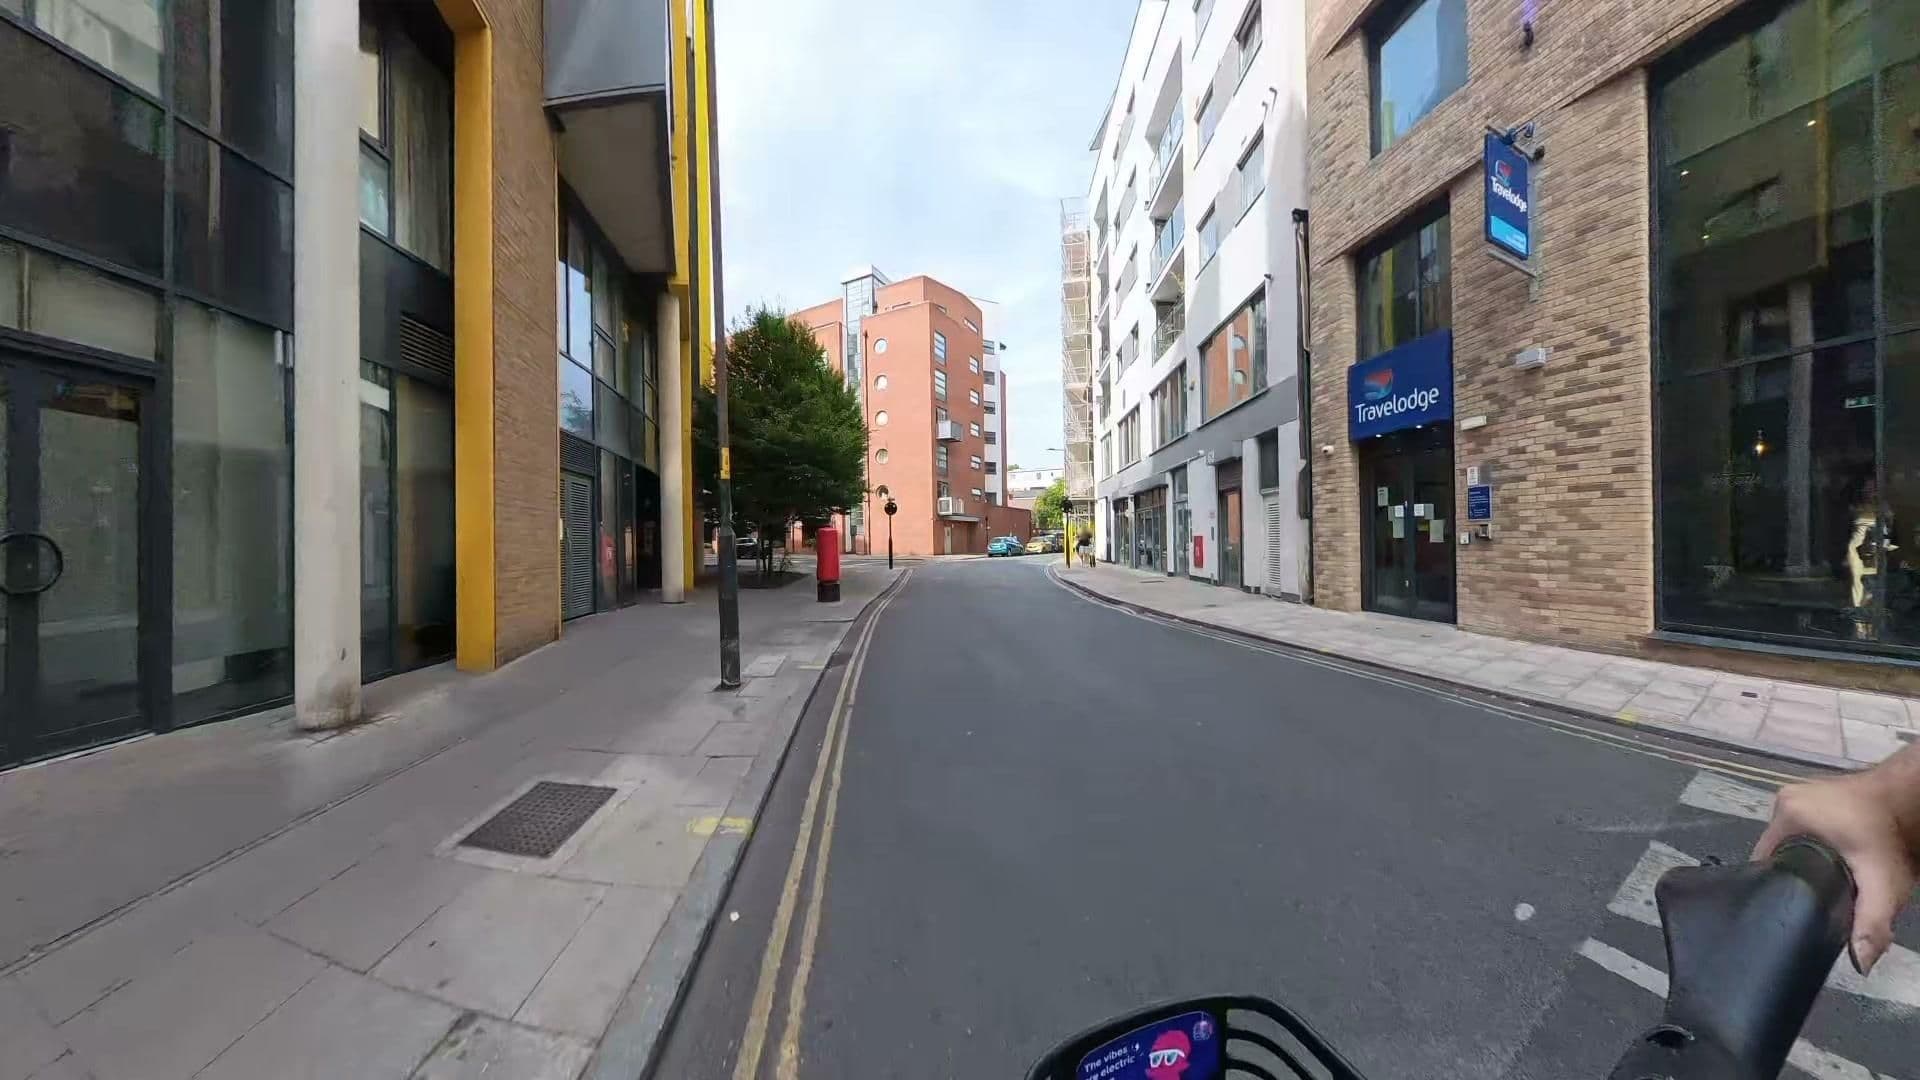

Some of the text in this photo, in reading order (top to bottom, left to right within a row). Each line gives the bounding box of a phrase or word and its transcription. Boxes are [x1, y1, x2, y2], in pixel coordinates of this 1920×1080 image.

[1491, 175, 1528, 213] Travelodge
[1355, 387, 1440, 423] Travelodge
[1084, 1047, 1128, 1073] The vibes
[1101, 1055, 1136, 1077] electric
